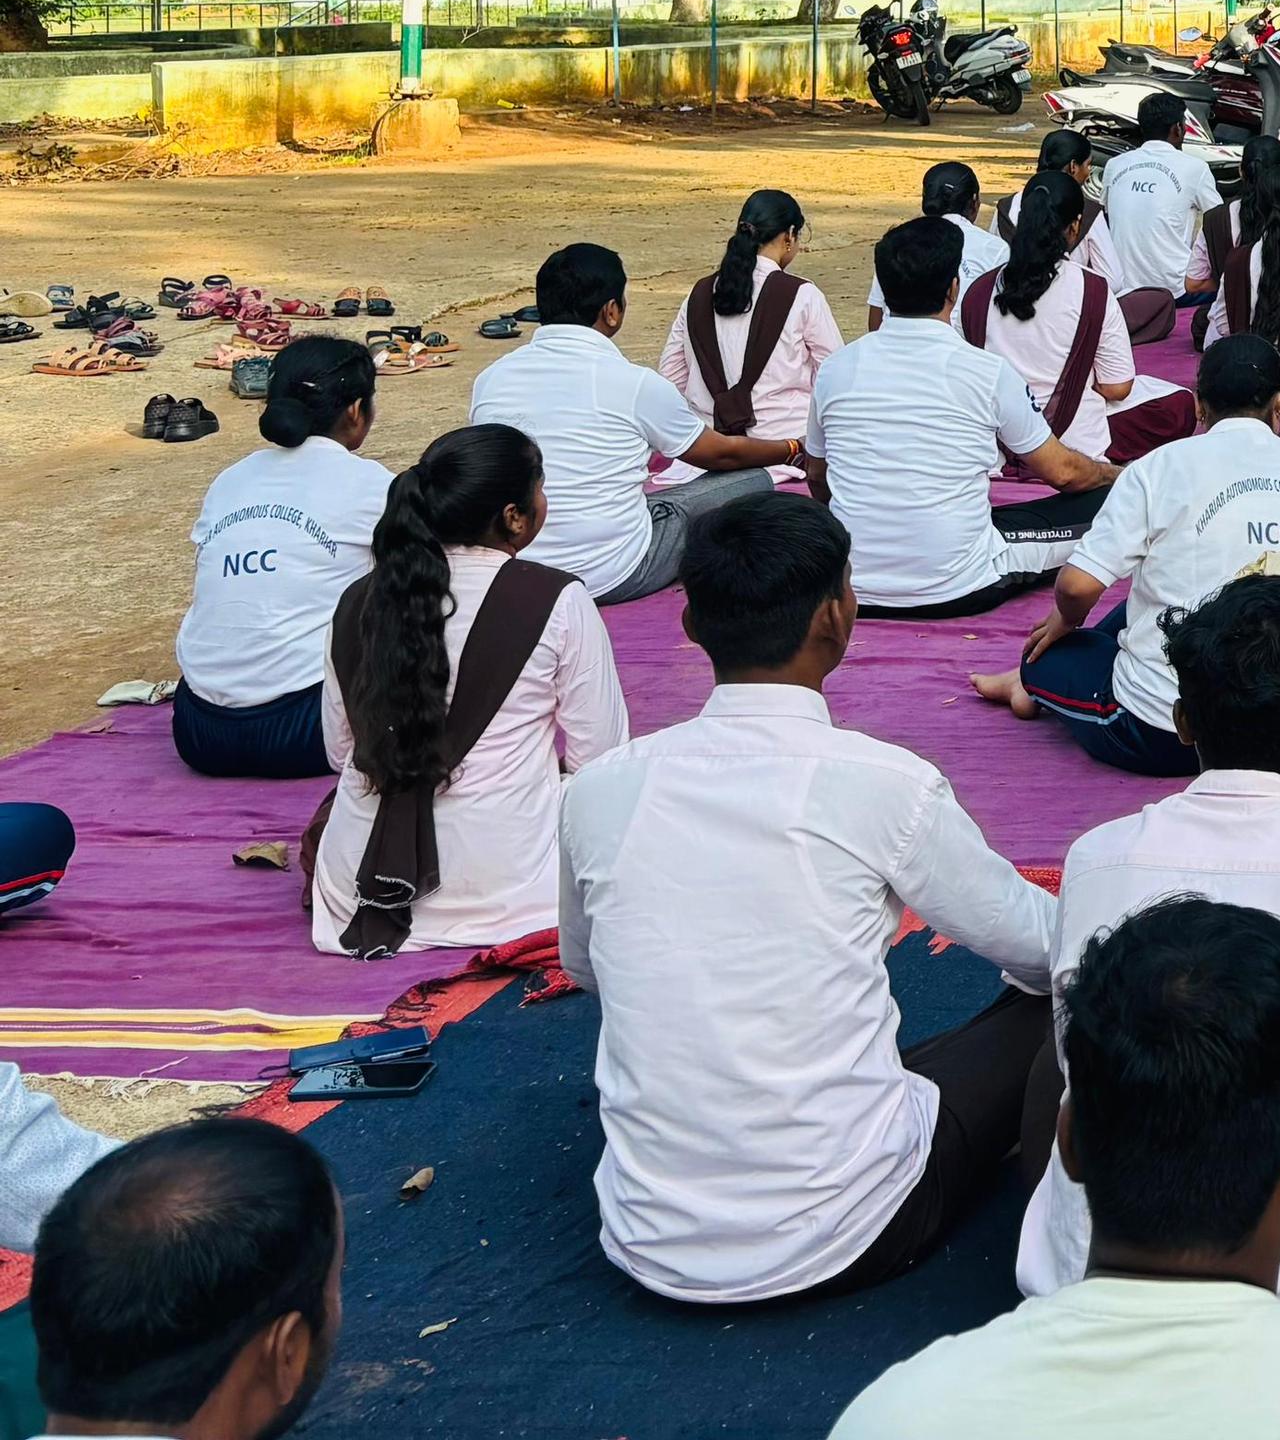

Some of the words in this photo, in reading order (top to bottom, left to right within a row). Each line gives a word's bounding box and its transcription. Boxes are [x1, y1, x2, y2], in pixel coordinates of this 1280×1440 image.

[1131, 181, 1157, 193] NCC
[1195, 492, 1226, 536] KHARIAR
[1226, 478, 1273, 502] AUTONOMOUS
[213, 504, 270, 536] AUTONOMOUS
[270, 504, 304, 529] COLLEGE,
[304, 517, 338, 559] KHARIAR
[223, 549, 277, 578] NCC
